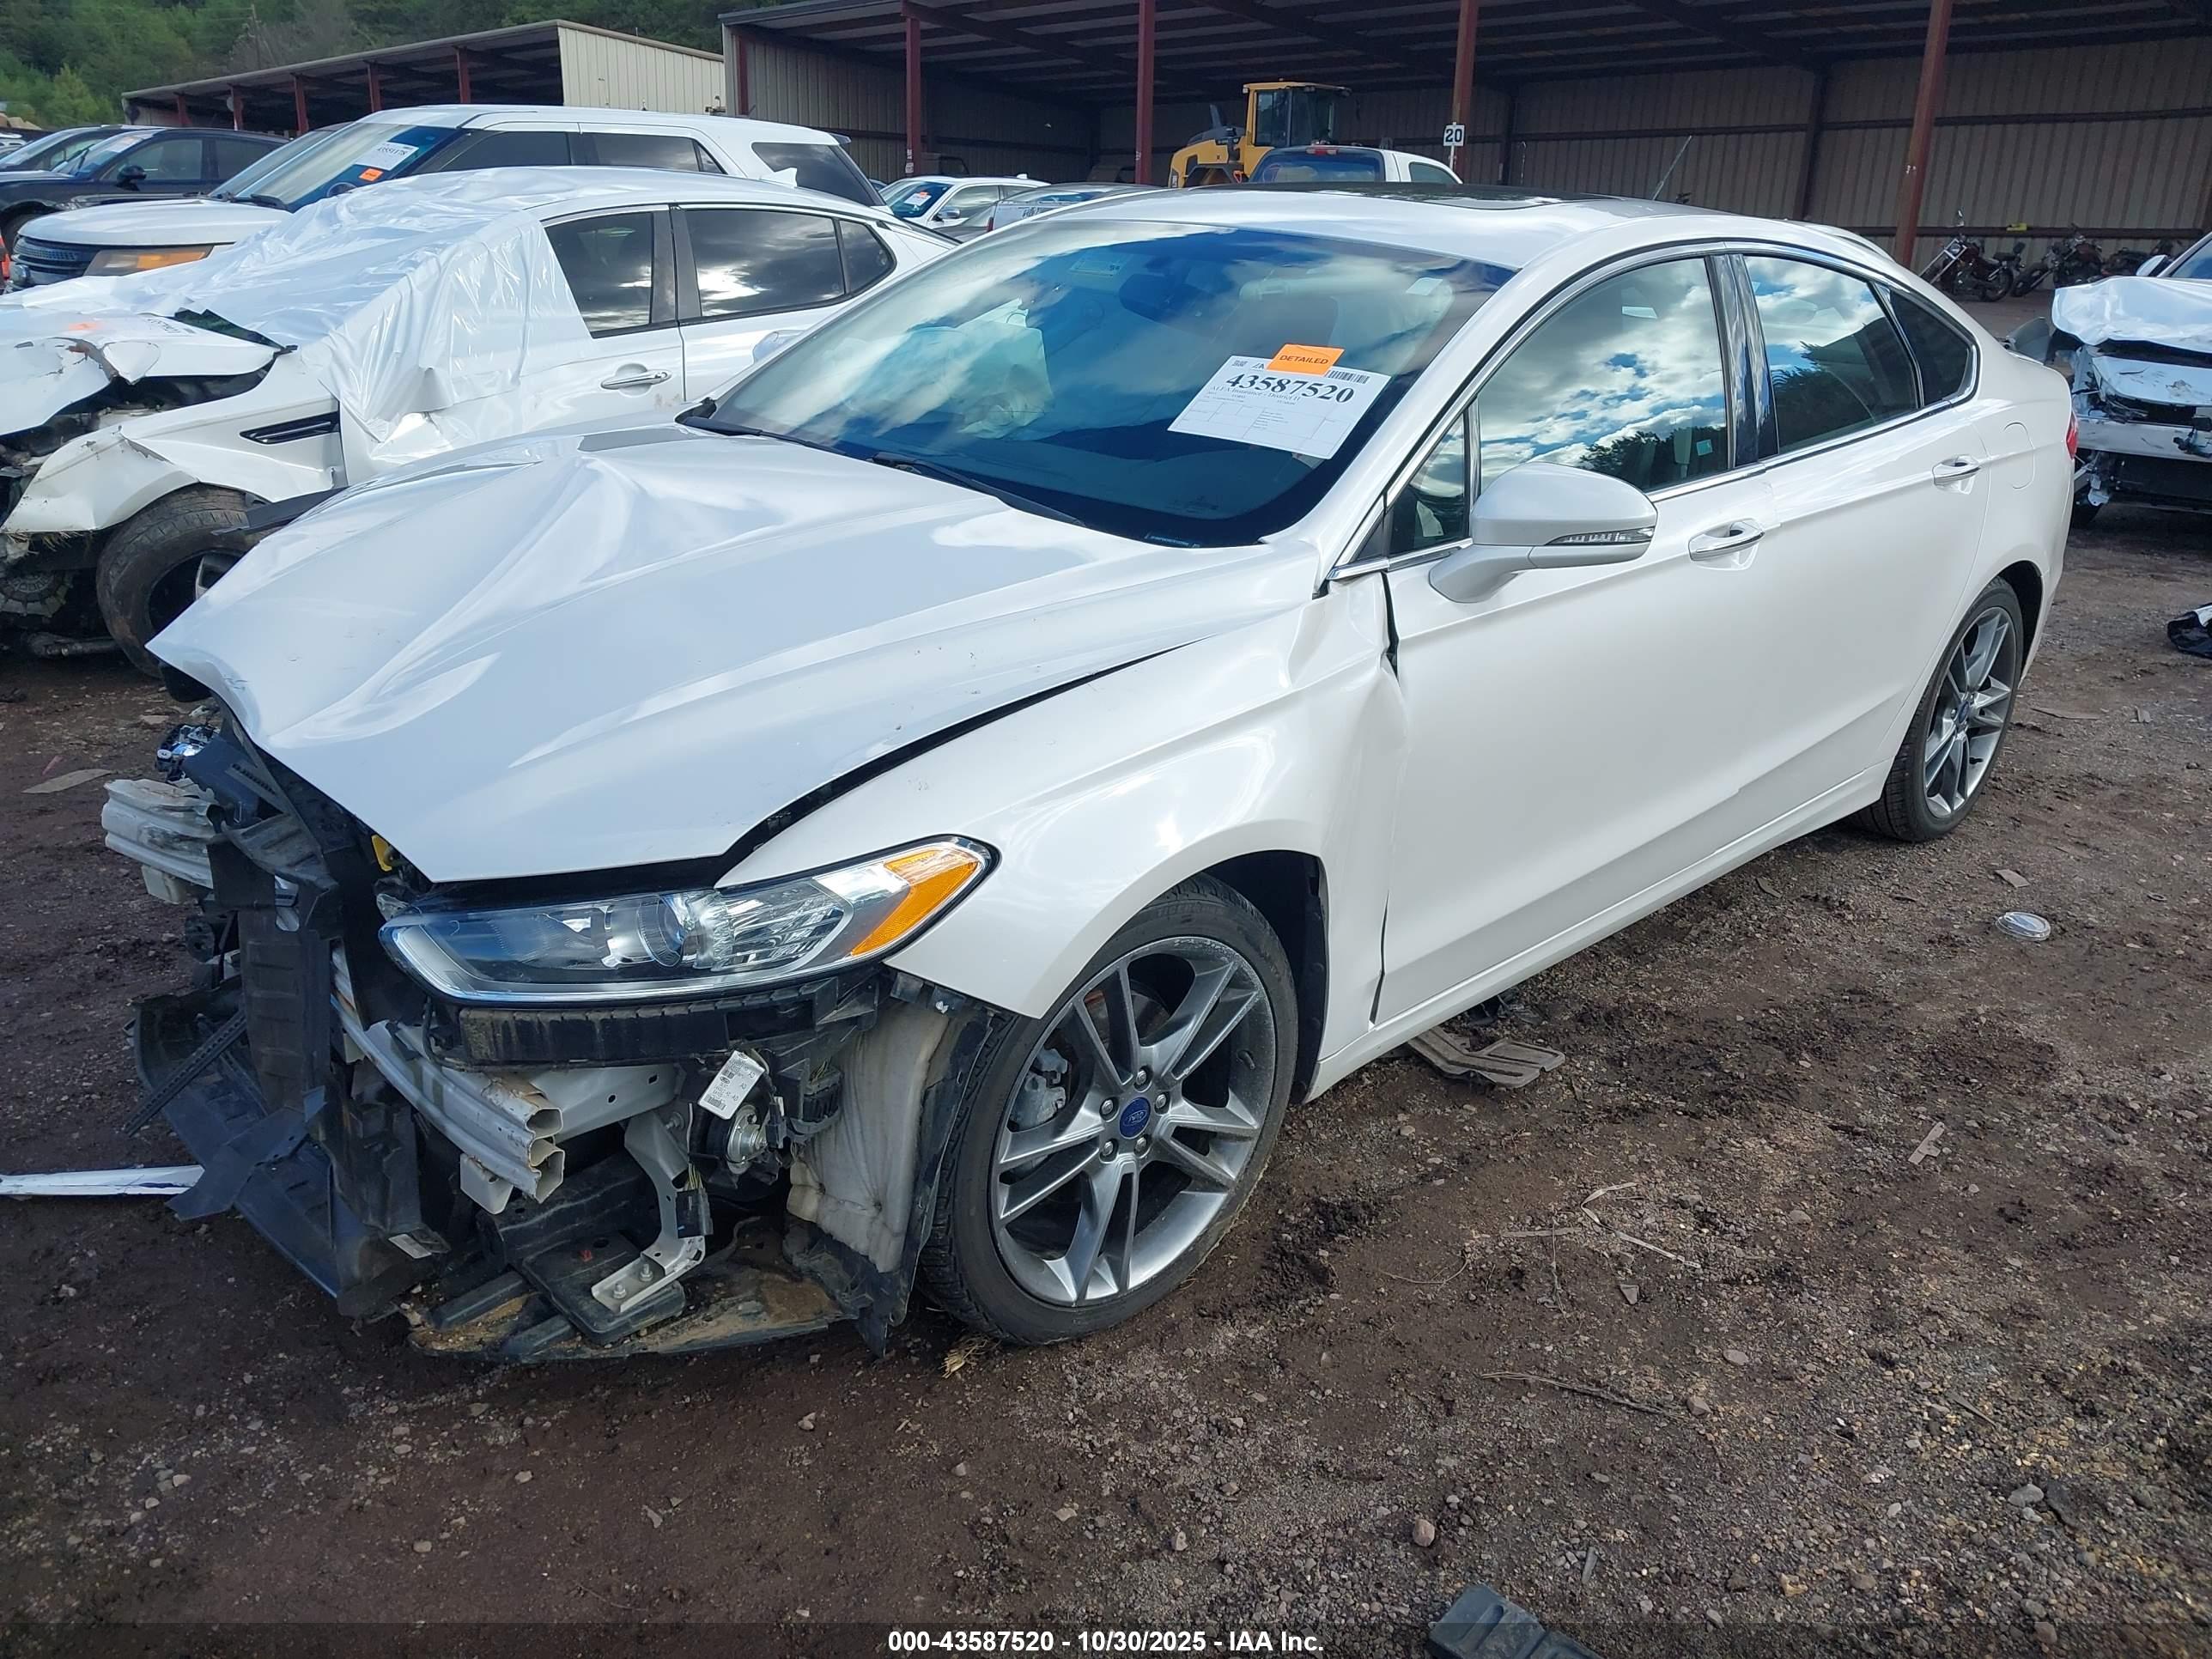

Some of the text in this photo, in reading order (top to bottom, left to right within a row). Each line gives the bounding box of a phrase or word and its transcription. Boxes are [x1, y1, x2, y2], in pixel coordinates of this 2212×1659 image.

[1445, 128, 1462, 143] 20
[1279, 354, 1328, 365] DETAILED
[1226, 374, 1354, 403] 43587520
[1231, 386, 1262, 397] Insurance
